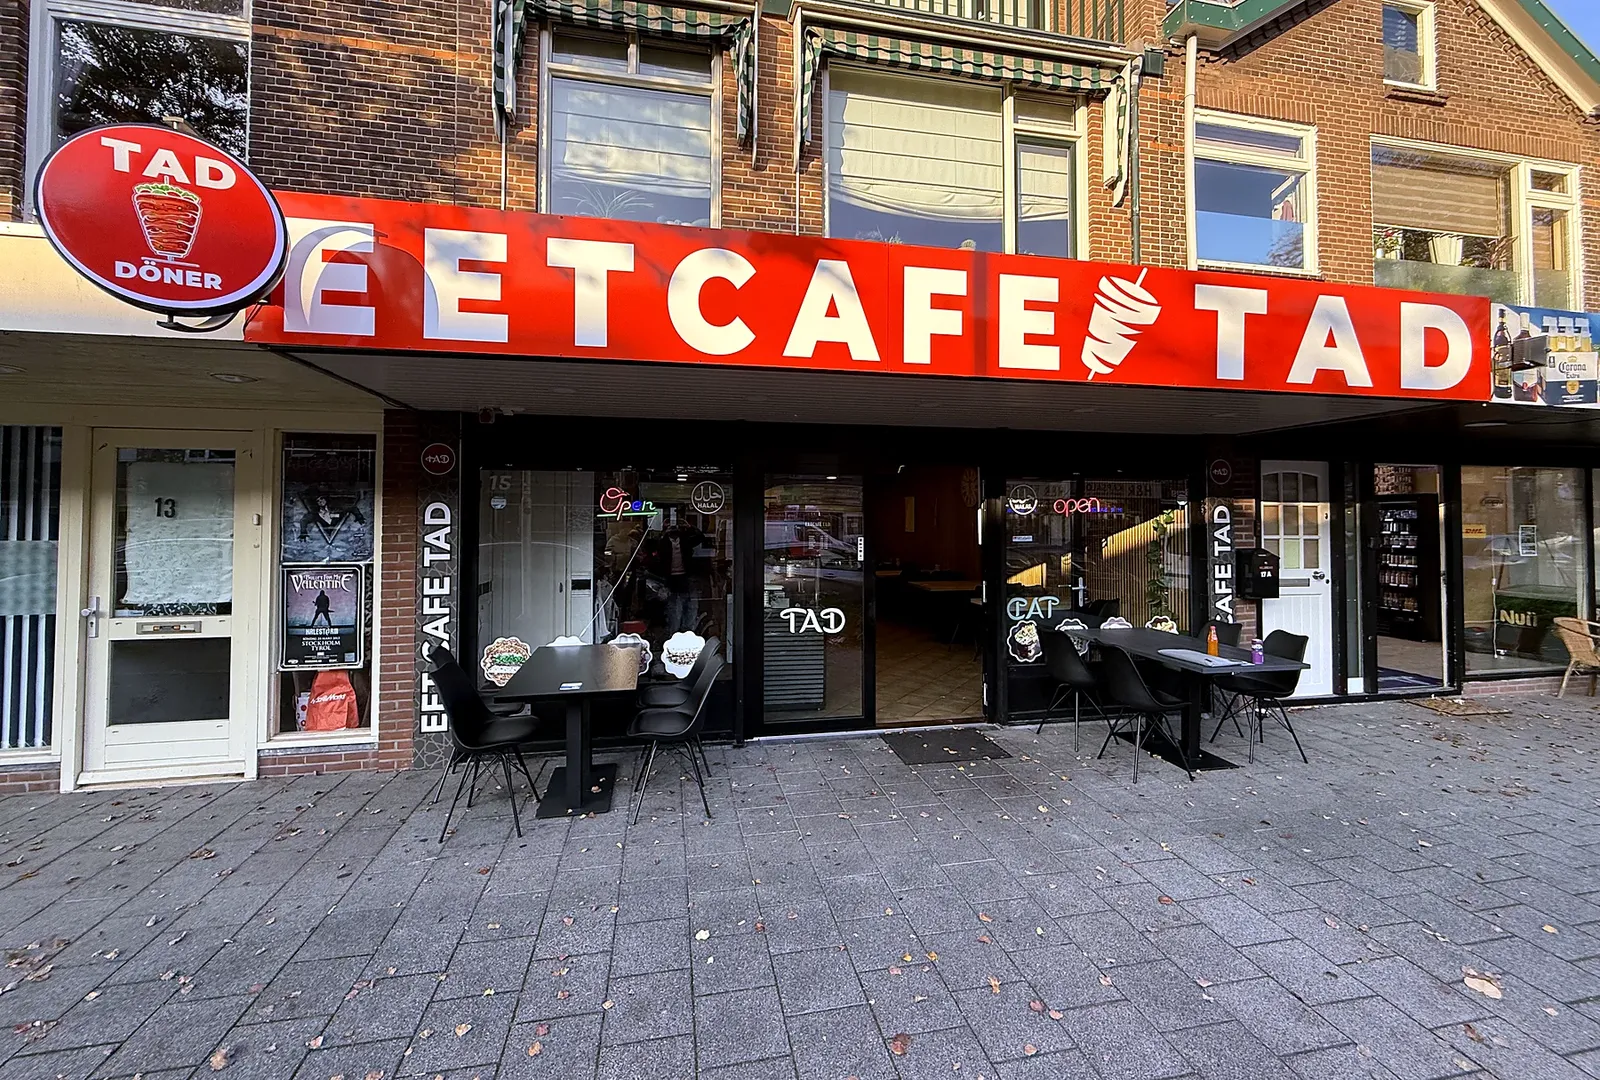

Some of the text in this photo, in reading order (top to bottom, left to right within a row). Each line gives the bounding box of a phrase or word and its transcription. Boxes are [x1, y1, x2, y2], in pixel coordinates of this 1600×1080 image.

[101, 136, 237, 190] TAD
[115, 260, 223, 291] DÖNER
[283, 216, 1473, 391] EETCAFE TAD
[1558, 361, 1587, 374] Corona
[490, 475, 512, 490] 15
[155, 497, 176, 519] 13
[600, 487, 656, 521] Open
[1054, 497, 1101, 518] open
[422, 502, 452, 568] TAD
[1213, 505, 1232, 557] TAD
[780, 607, 846, 634] TAD
[1500, 610, 1538, 627] Nuii
